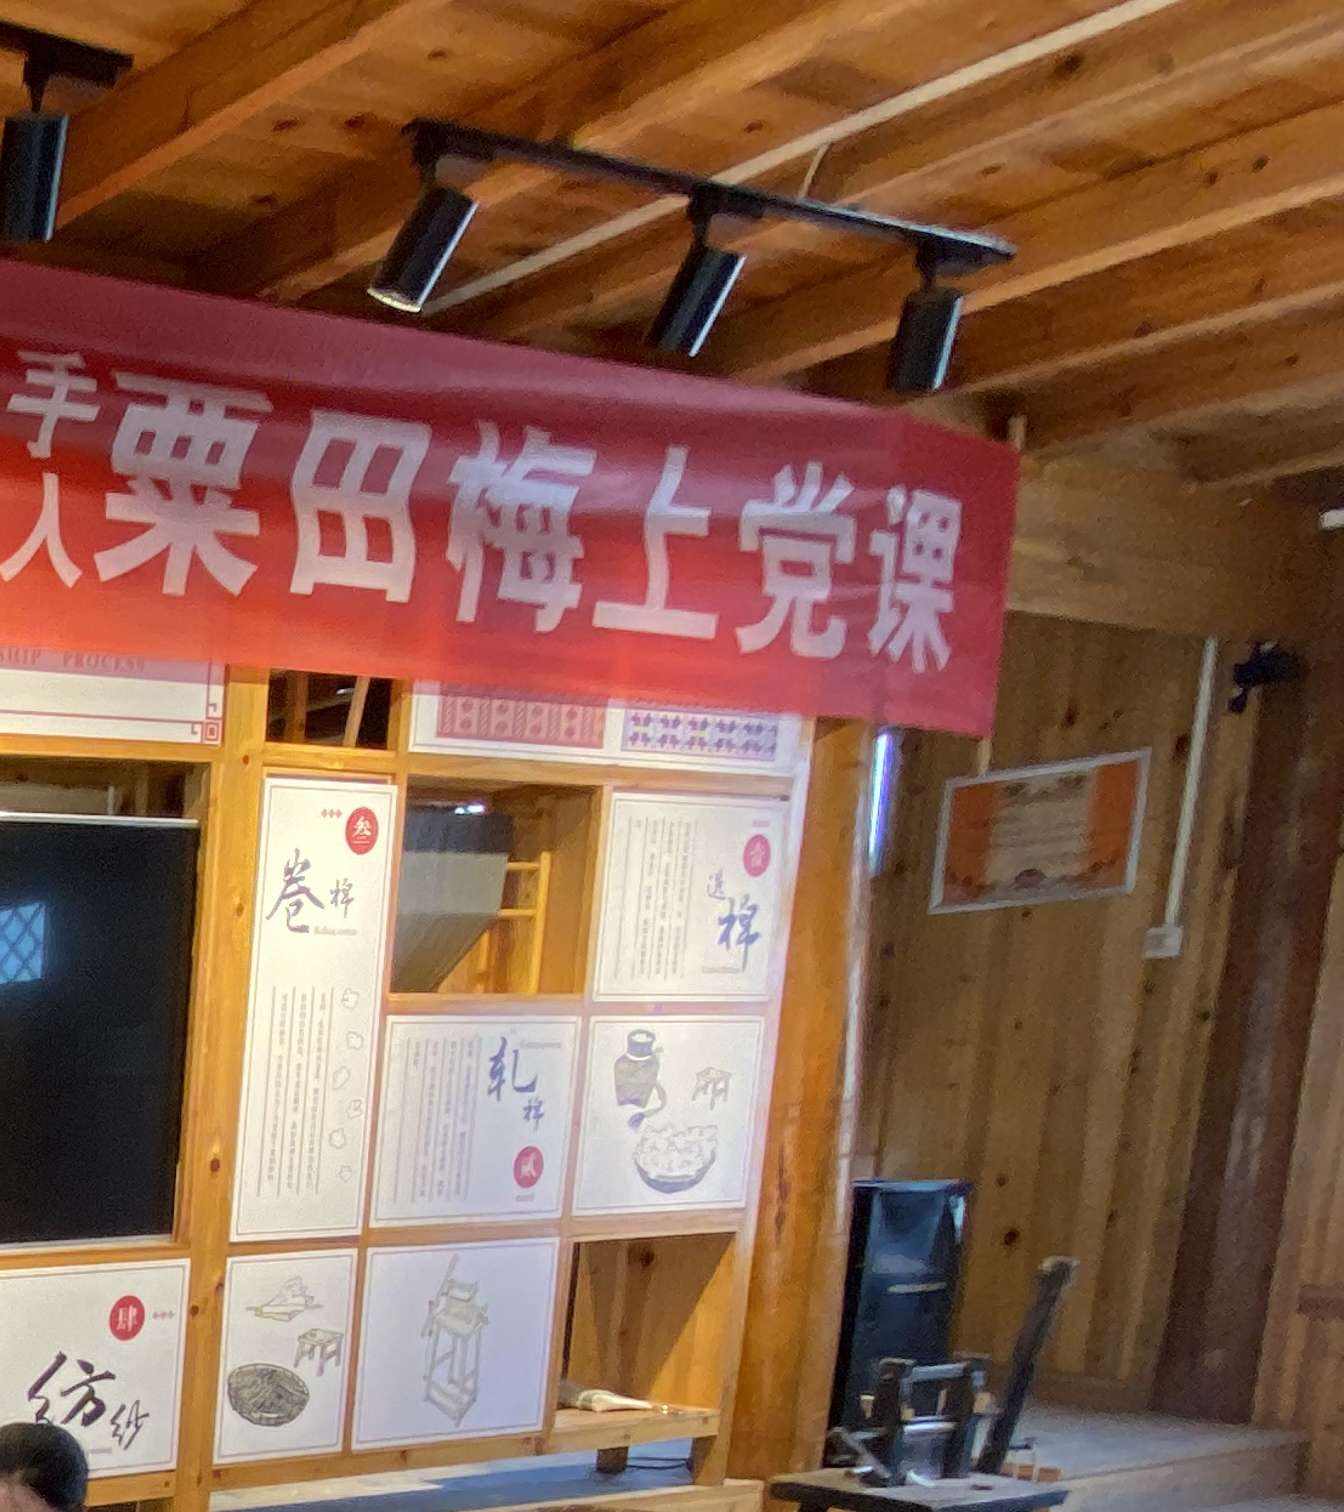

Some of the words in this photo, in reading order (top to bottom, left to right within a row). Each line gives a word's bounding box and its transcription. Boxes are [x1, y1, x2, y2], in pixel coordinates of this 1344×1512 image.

[94, 370, 967, 675] 粟田梅上党课
[353, 817, 372, 844] 叁
[266, 848, 355, 933] 卷棉
[118, 1305, 138, 1332] 肆
